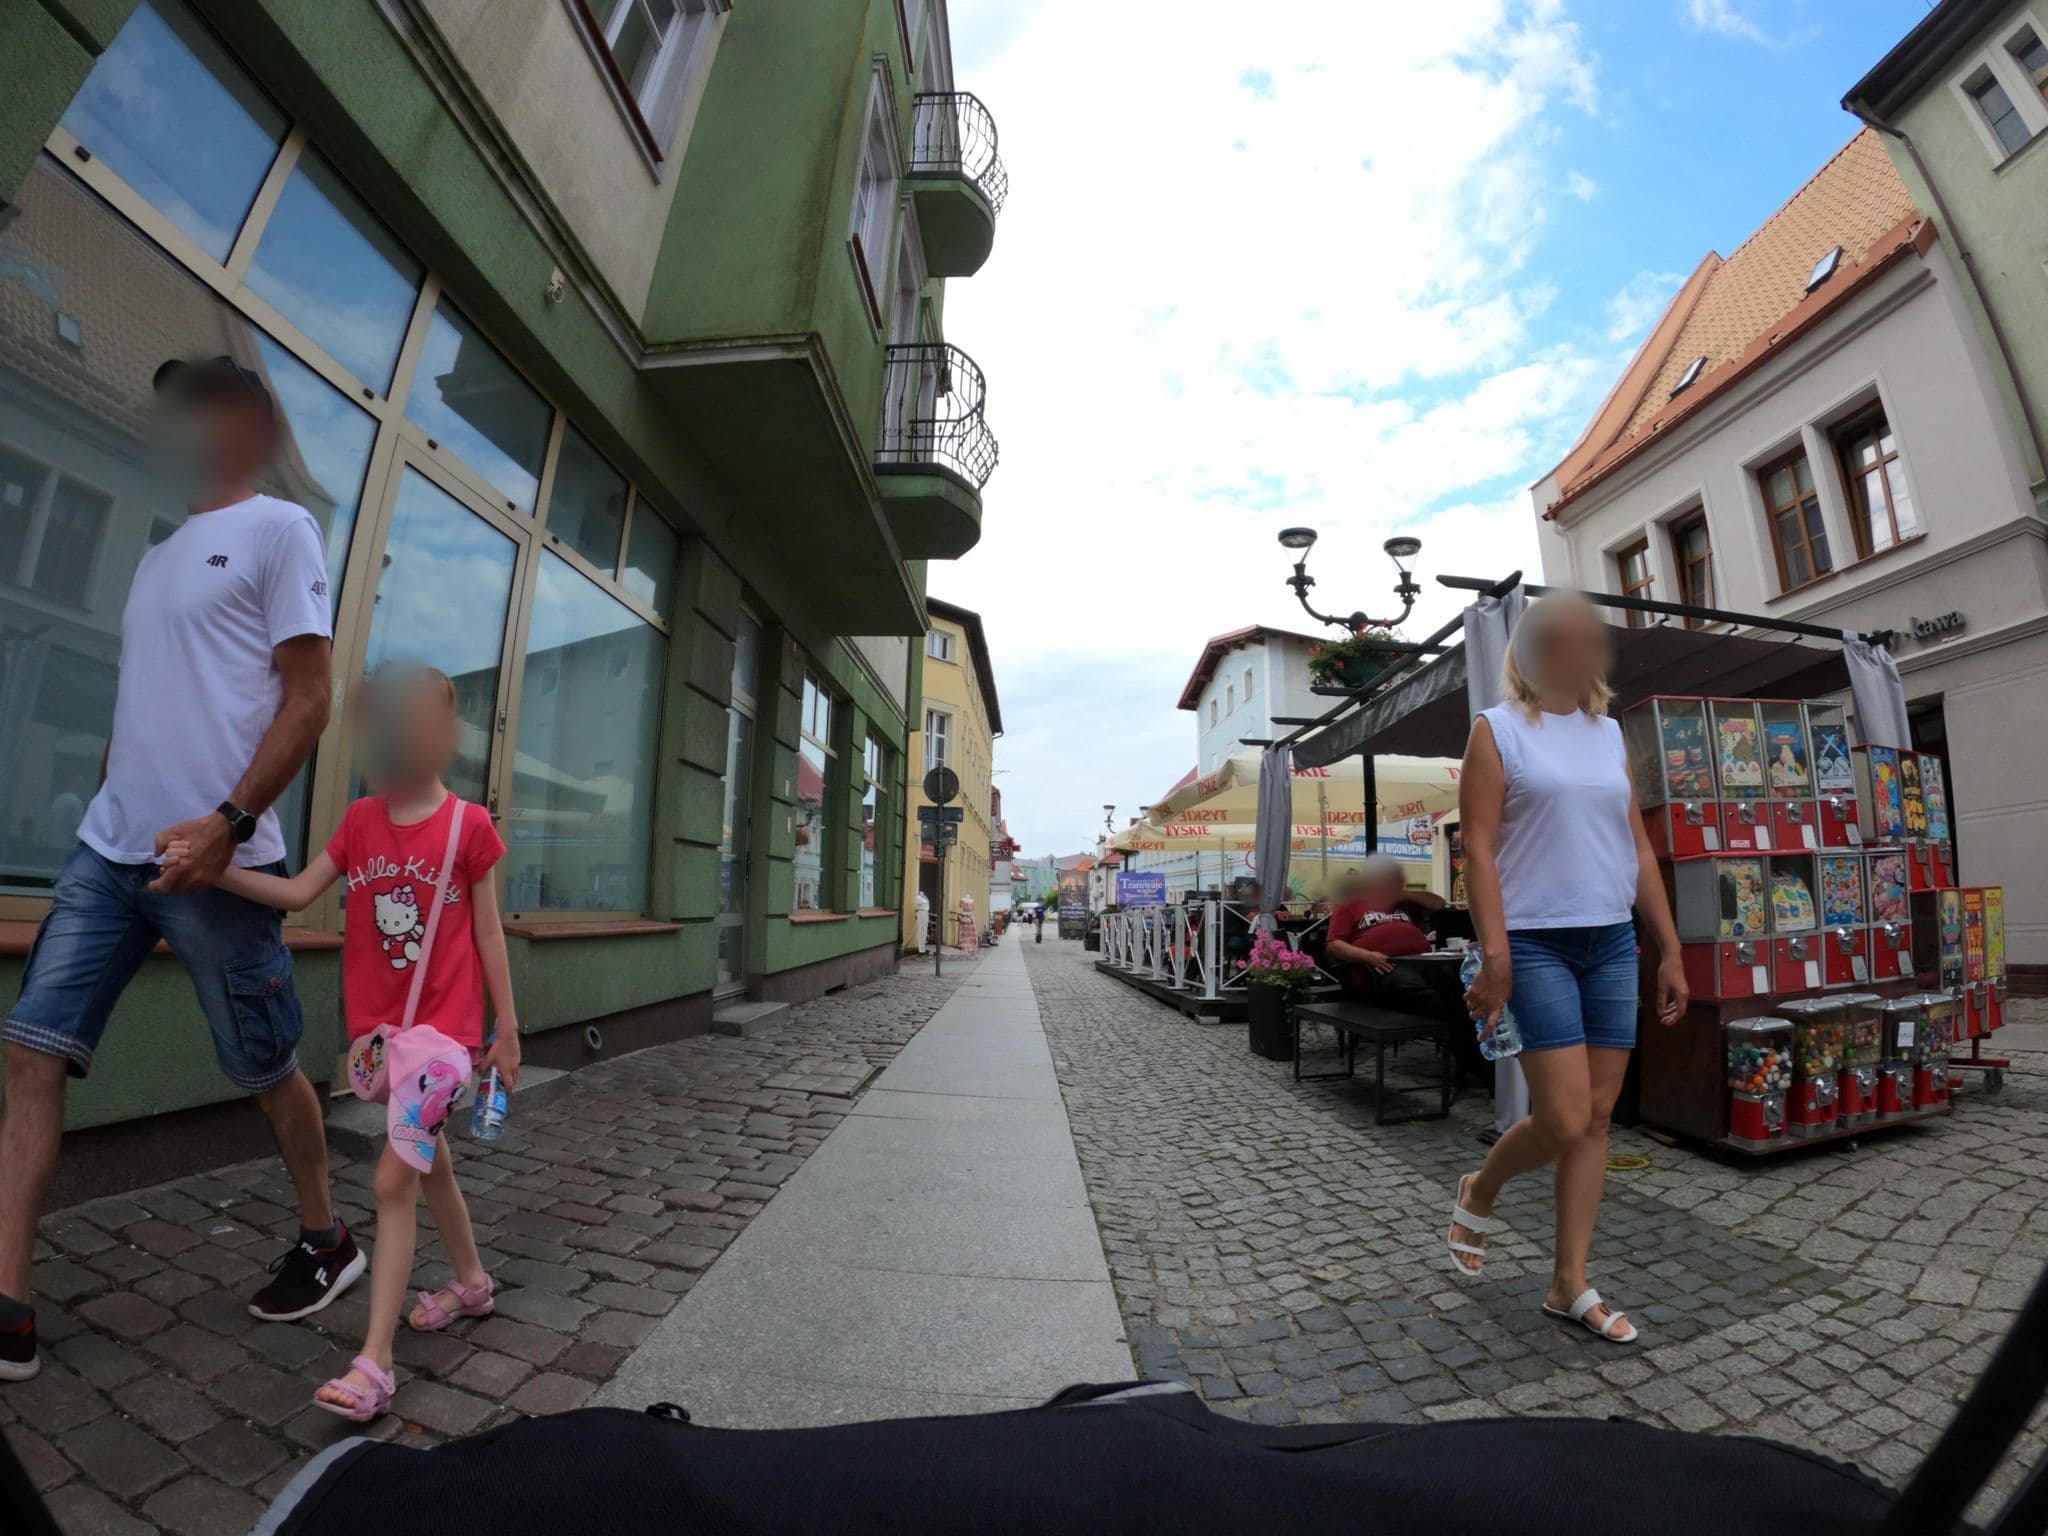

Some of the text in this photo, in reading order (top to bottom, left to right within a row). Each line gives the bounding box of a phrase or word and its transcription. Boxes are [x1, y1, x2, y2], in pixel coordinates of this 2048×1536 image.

[1165, 825, 1211, 837] TYSKIE
[347, 855, 461, 904] Hello Kiy
